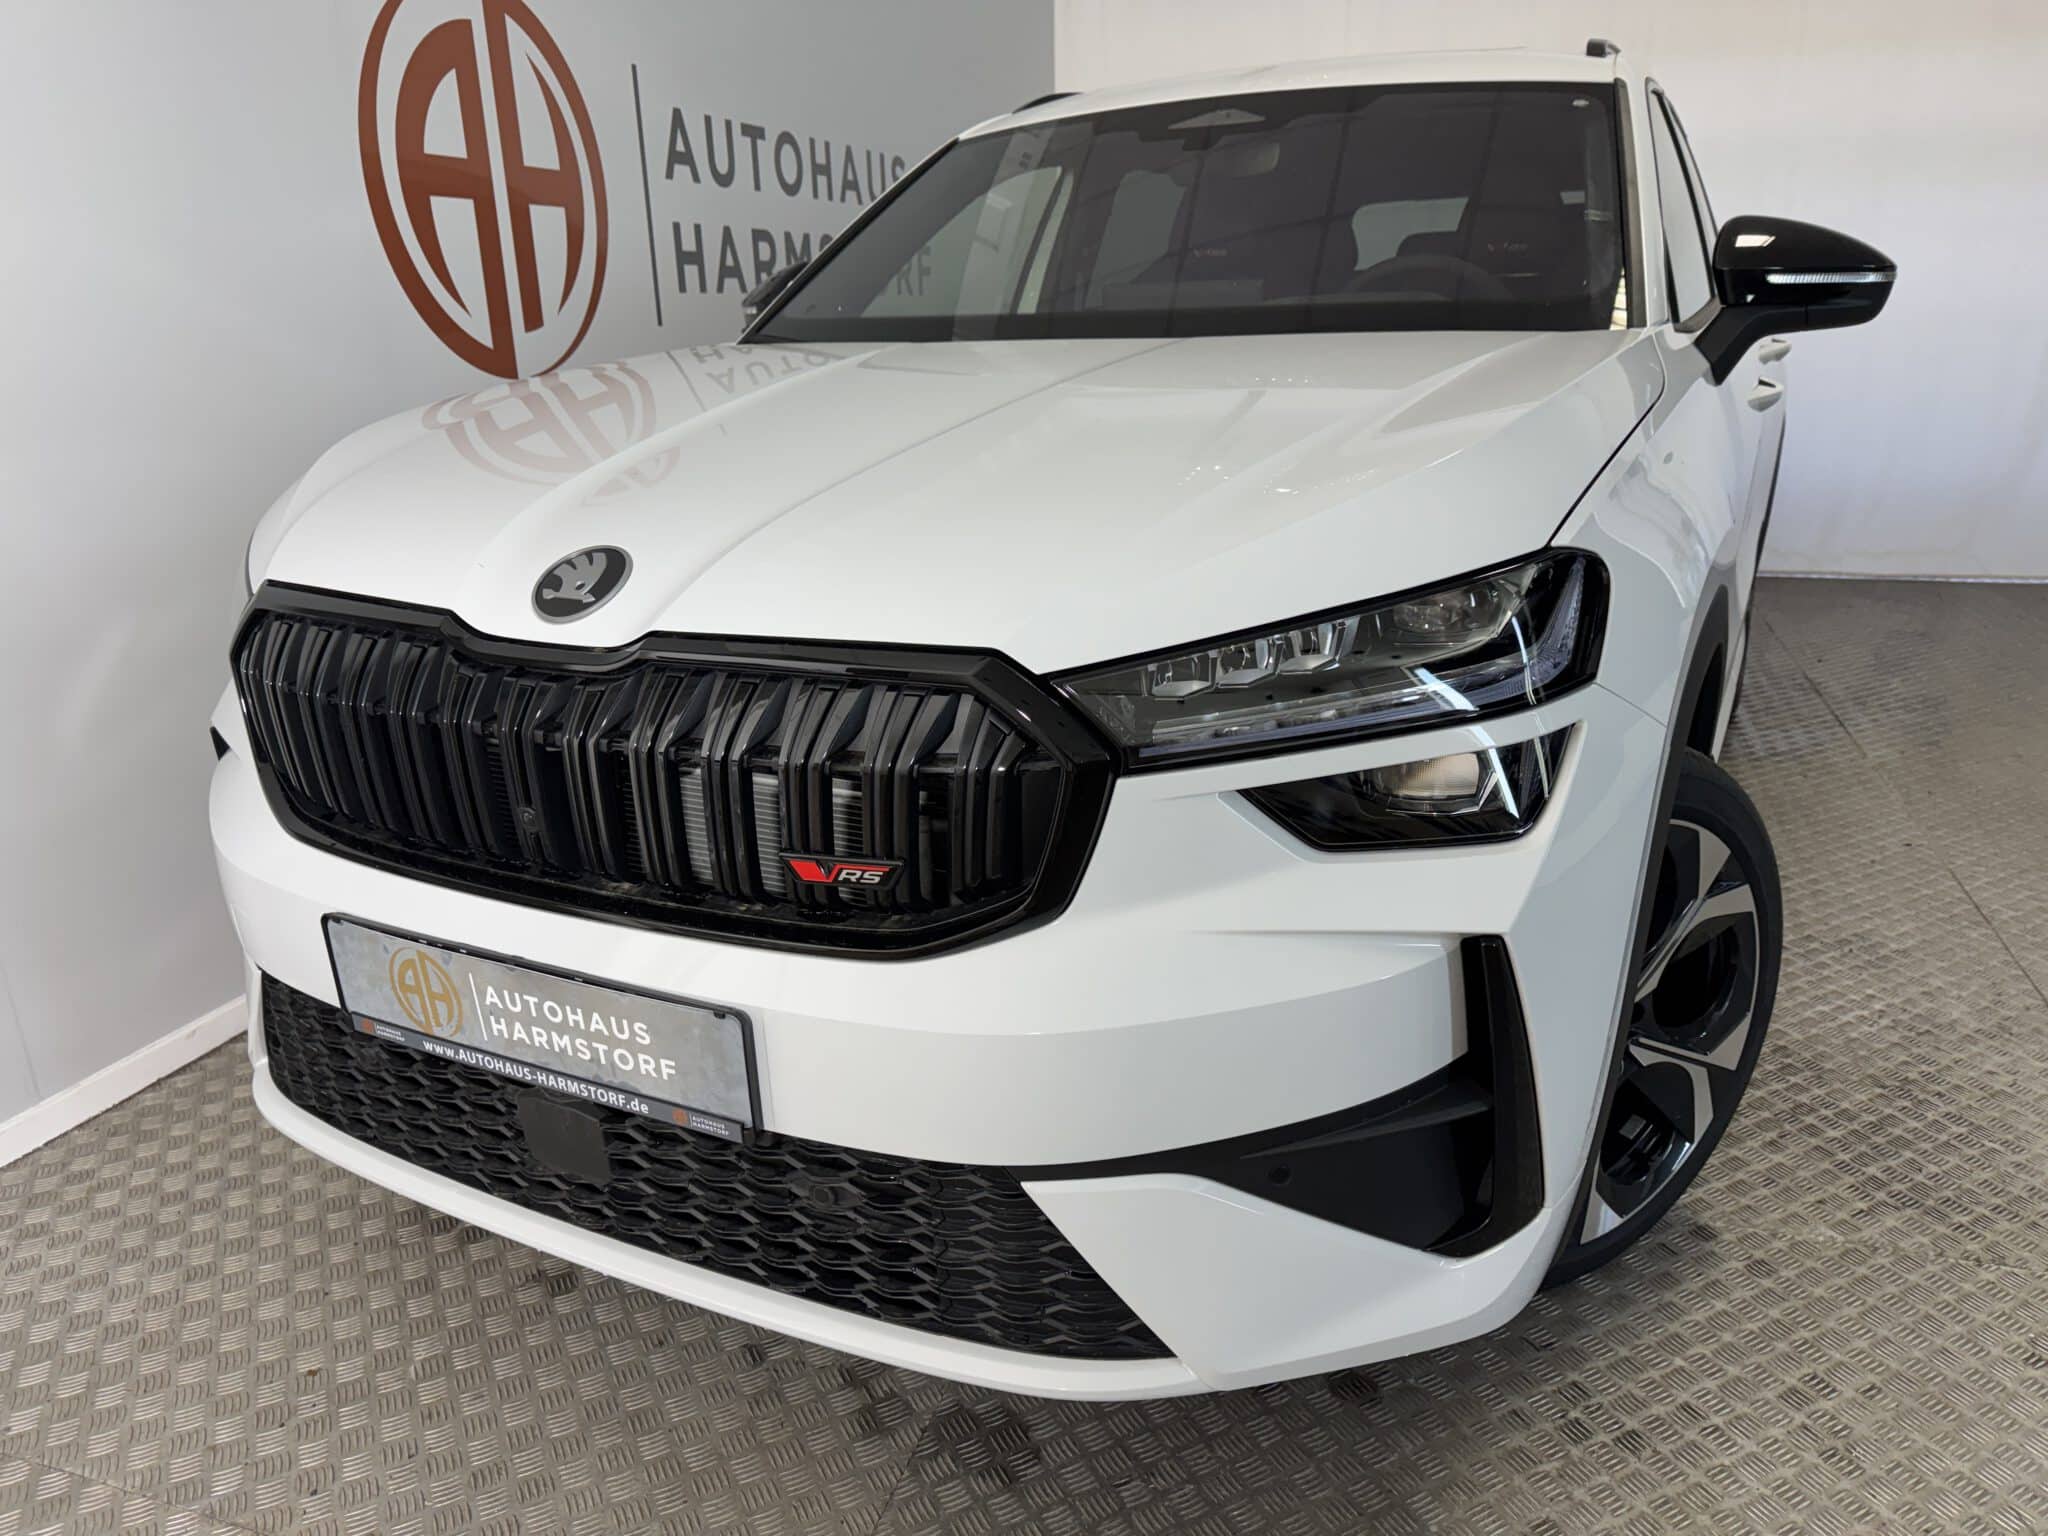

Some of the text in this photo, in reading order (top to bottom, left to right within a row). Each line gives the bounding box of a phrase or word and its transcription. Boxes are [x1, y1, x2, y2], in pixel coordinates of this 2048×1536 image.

[485, 985, 650, 1045] AUTOHAUS
[490, 1015, 677, 1081] HARMSTORF
[423, 1040, 649, 1115] www.AUTOHAUS-HARMSTORF.de
